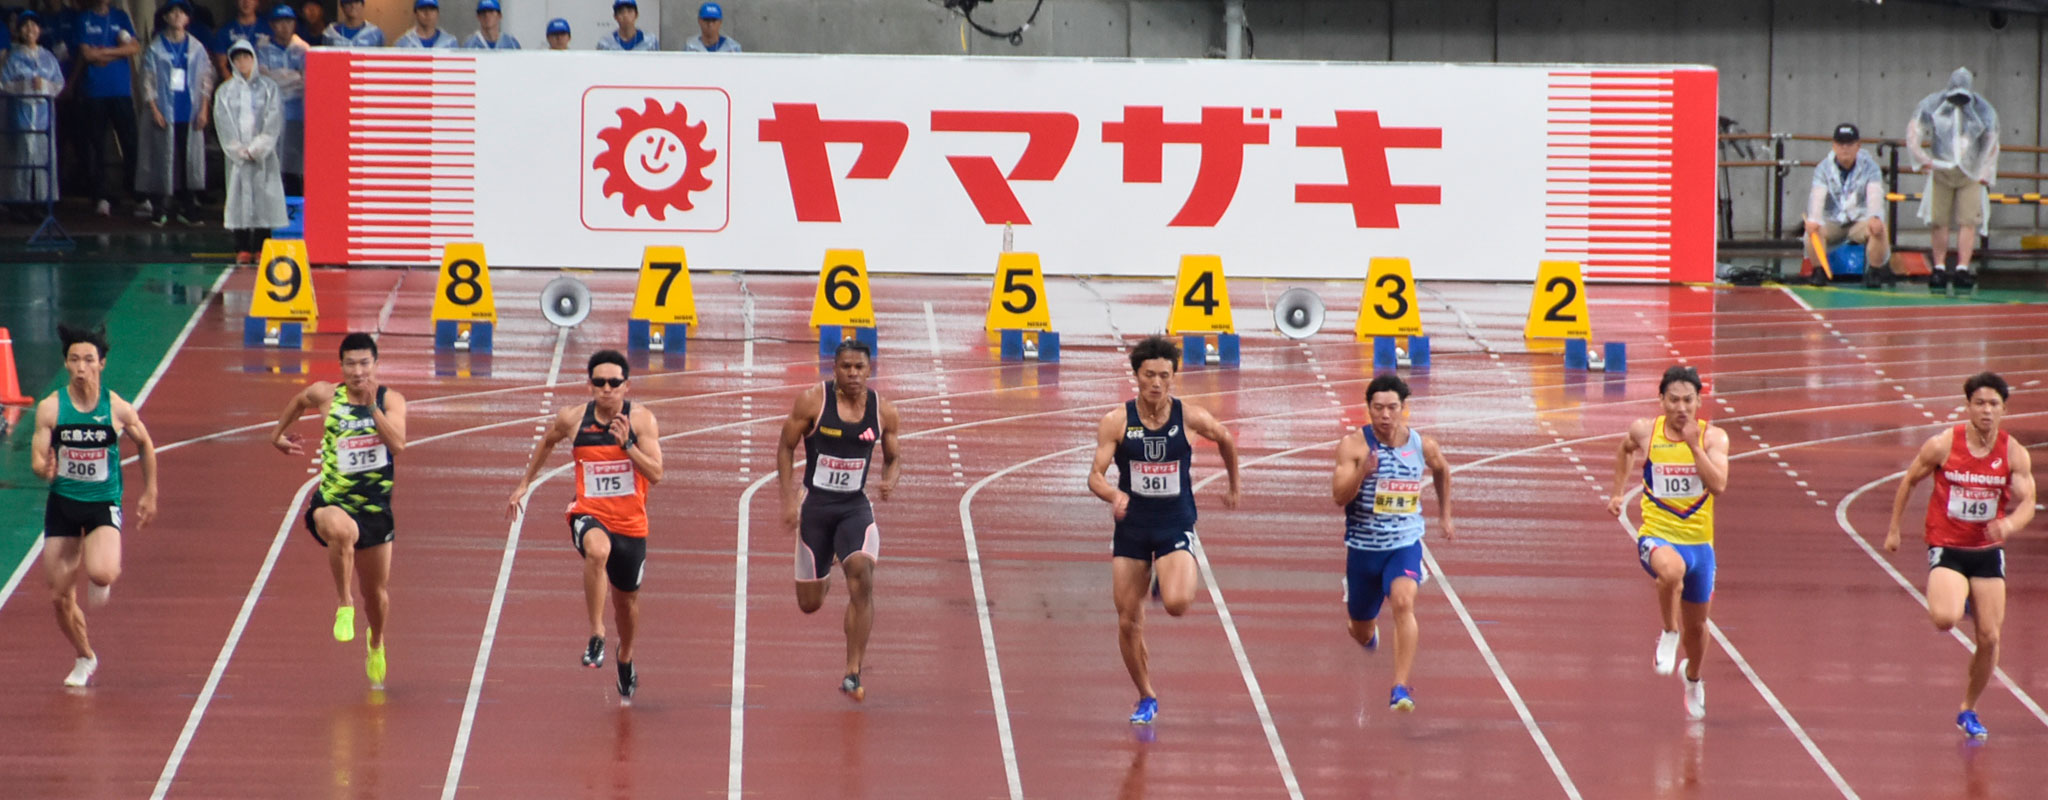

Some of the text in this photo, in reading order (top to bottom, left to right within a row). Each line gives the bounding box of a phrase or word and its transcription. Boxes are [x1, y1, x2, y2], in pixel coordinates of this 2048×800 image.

[759, 103, 1442, 228] ヤマザキ
[265, 255, 301, 303] 9
[446, 259, 483, 306] 8
[649, 262, 682, 307] 7
[824, 264, 861, 311] 6
[1001, 268, 1037, 314] 5
[1183, 271, 1219, 316] 4
[1373, 273, 1408, 320] 3
[1544, 276, 1577, 322] 2
[61, 429, 107, 442] 広島大学
[348, 449, 377, 466] 375
[67, 461, 96, 476] 206
[596, 476, 622, 491] 175
[829, 471, 850, 486] 112
[1142, 476, 1167, 490] 361
[1665, 478, 1690, 492] 103
[1962, 501, 1988, 515] 149
